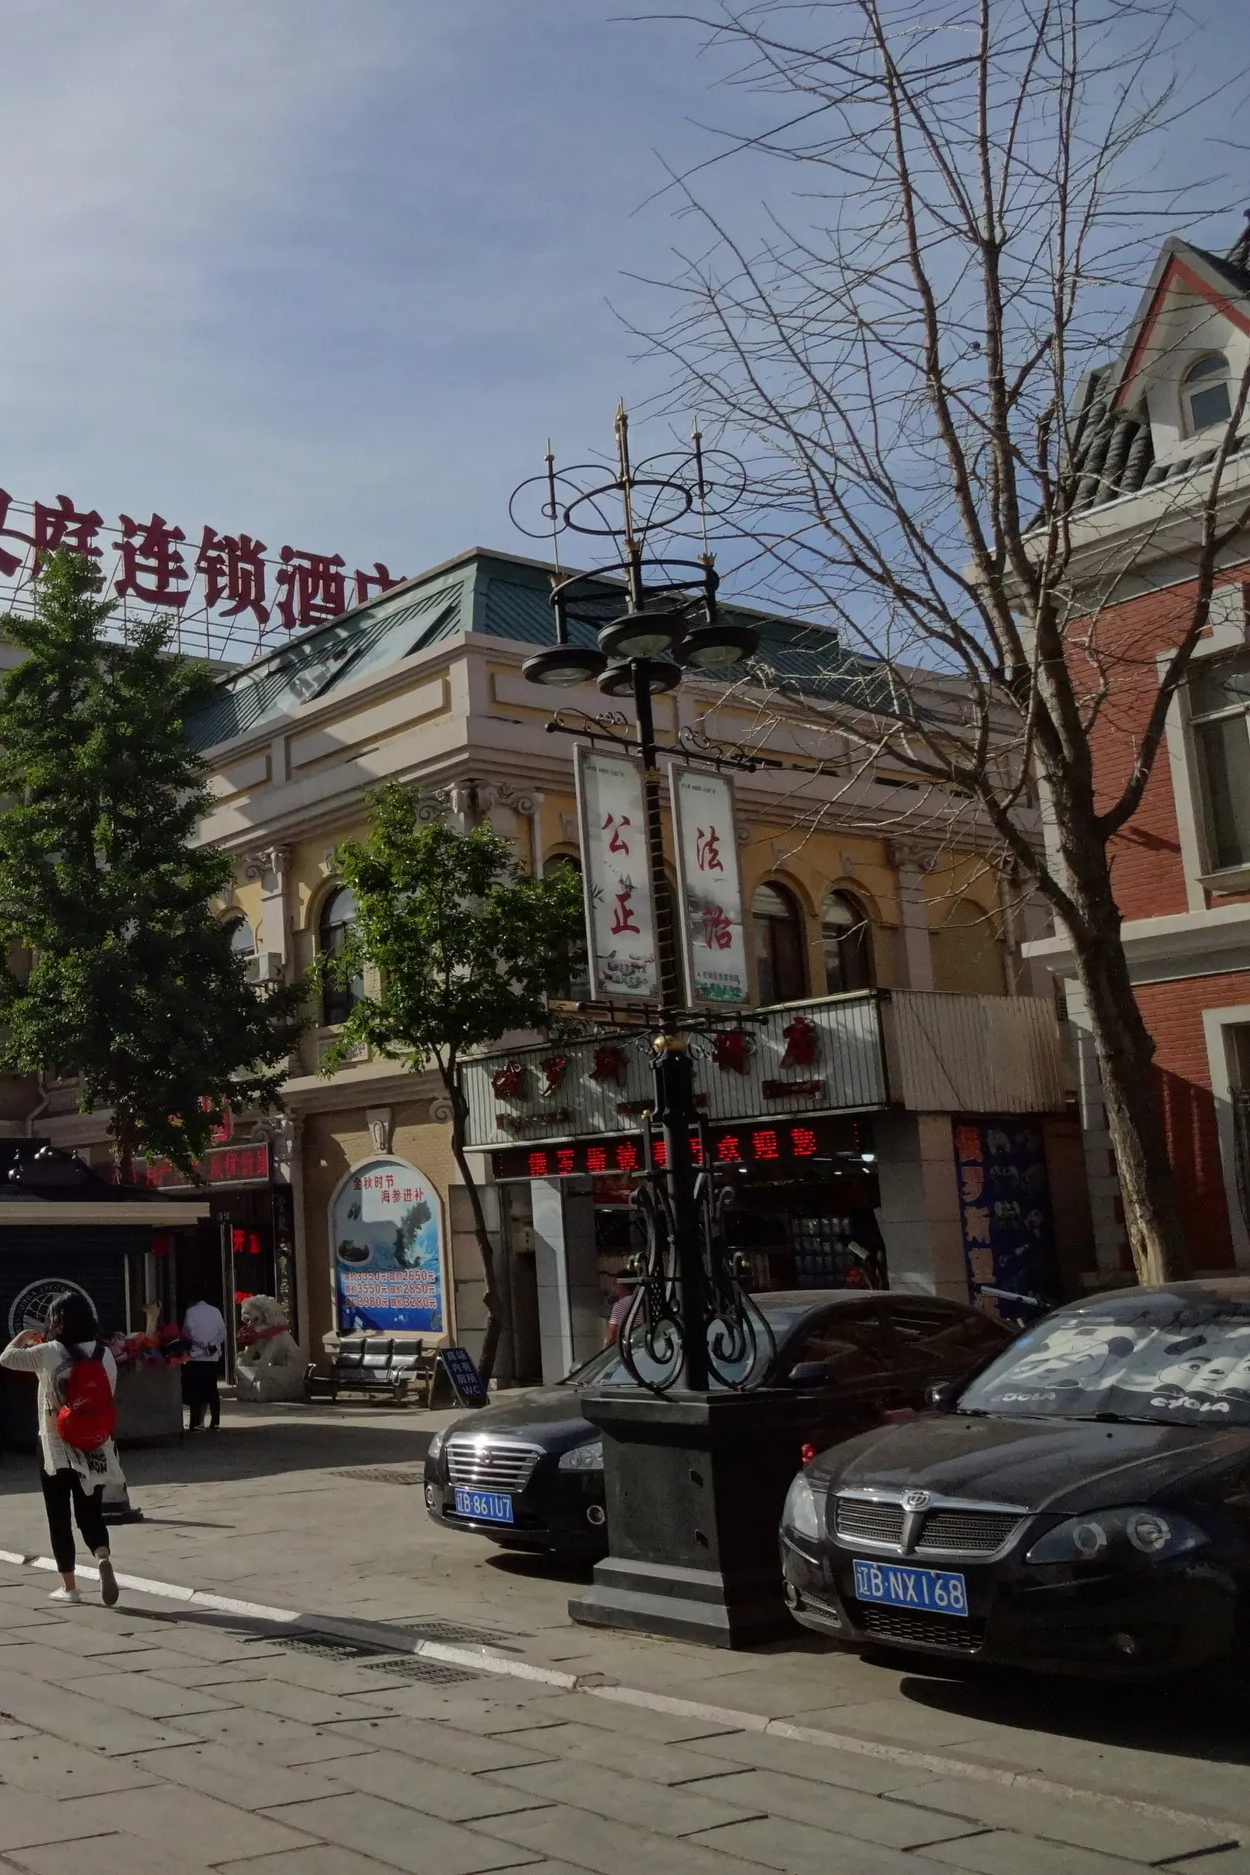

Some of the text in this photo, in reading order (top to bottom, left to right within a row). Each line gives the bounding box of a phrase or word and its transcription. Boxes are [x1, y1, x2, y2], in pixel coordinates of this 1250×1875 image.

[601, 812, 641, 935] 公正
[696, 825, 733, 951] 法治
[353, 1174, 395, 1191] 金秋时节
[381, 1188, 424, 1204] 海参进补
[462, 1384, 482, 1396] WC
